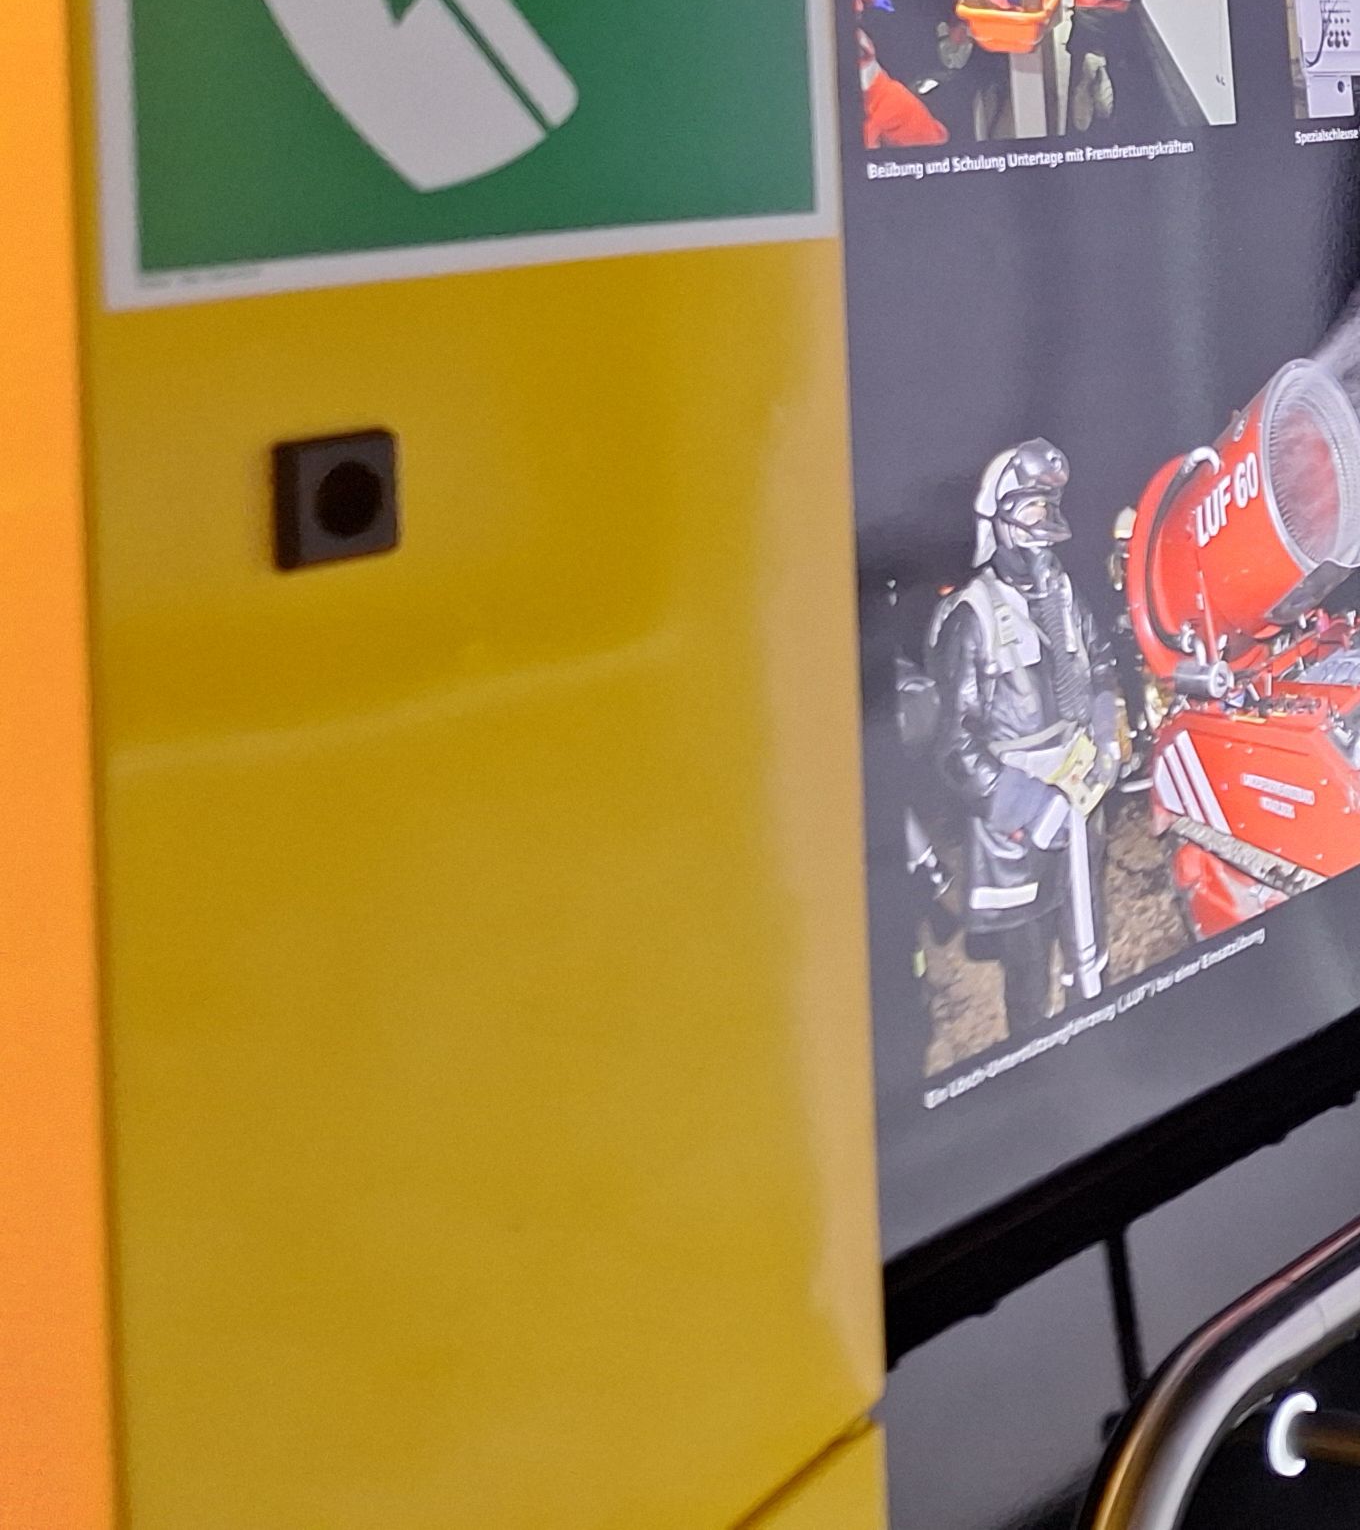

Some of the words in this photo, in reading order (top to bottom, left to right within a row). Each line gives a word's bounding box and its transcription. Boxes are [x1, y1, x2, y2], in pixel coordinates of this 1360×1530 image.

[866, 161, 924, 180] Beübung
[925, 157, 951, 175] und
[951, 154, 1006, 173] Schulung
[1006, 151, 1064, 168] Untertage
[1064, 147, 1085, 162] mit
[1085, 139, 1194, 161] Fremdrettungskräften
[1294, 127, 1359, 146] Spezialschleuse
[1195, 475, 1232, 548] LUF
[1233, 452, 1259, 509] 60
[1155, 971, 1176, 992] bei
[1173, 956, 1202, 983] einer
[1199, 928, 1266, 969] Einsatzübung
